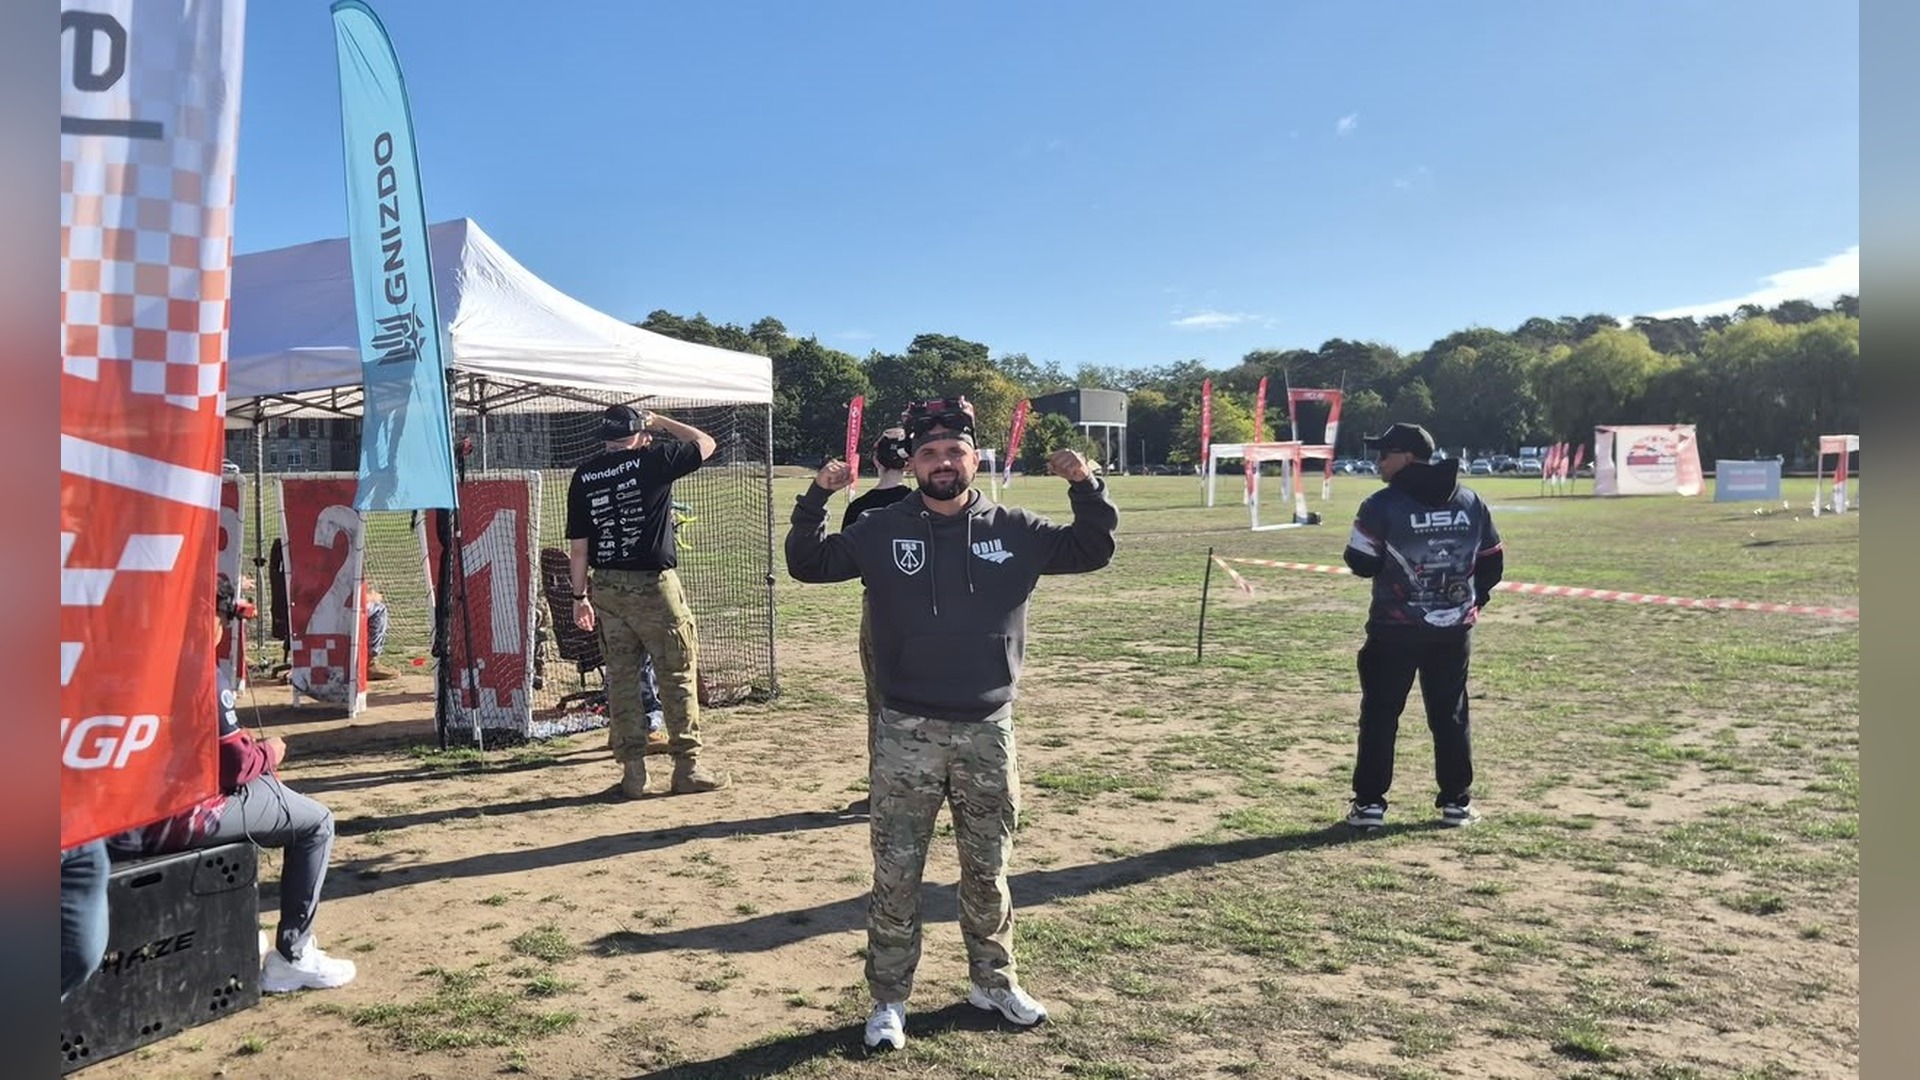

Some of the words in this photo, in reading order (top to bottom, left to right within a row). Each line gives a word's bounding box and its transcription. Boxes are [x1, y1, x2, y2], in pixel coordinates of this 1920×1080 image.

[374, 131, 408, 305] GNIZDO
[581, 458, 640, 483] WonderFPV
[1410, 510, 1470, 528] USA
[305, 505, 361, 635] 2
[462, 508, 521, 653] 1
[102, 930, 196, 977] HAZE
